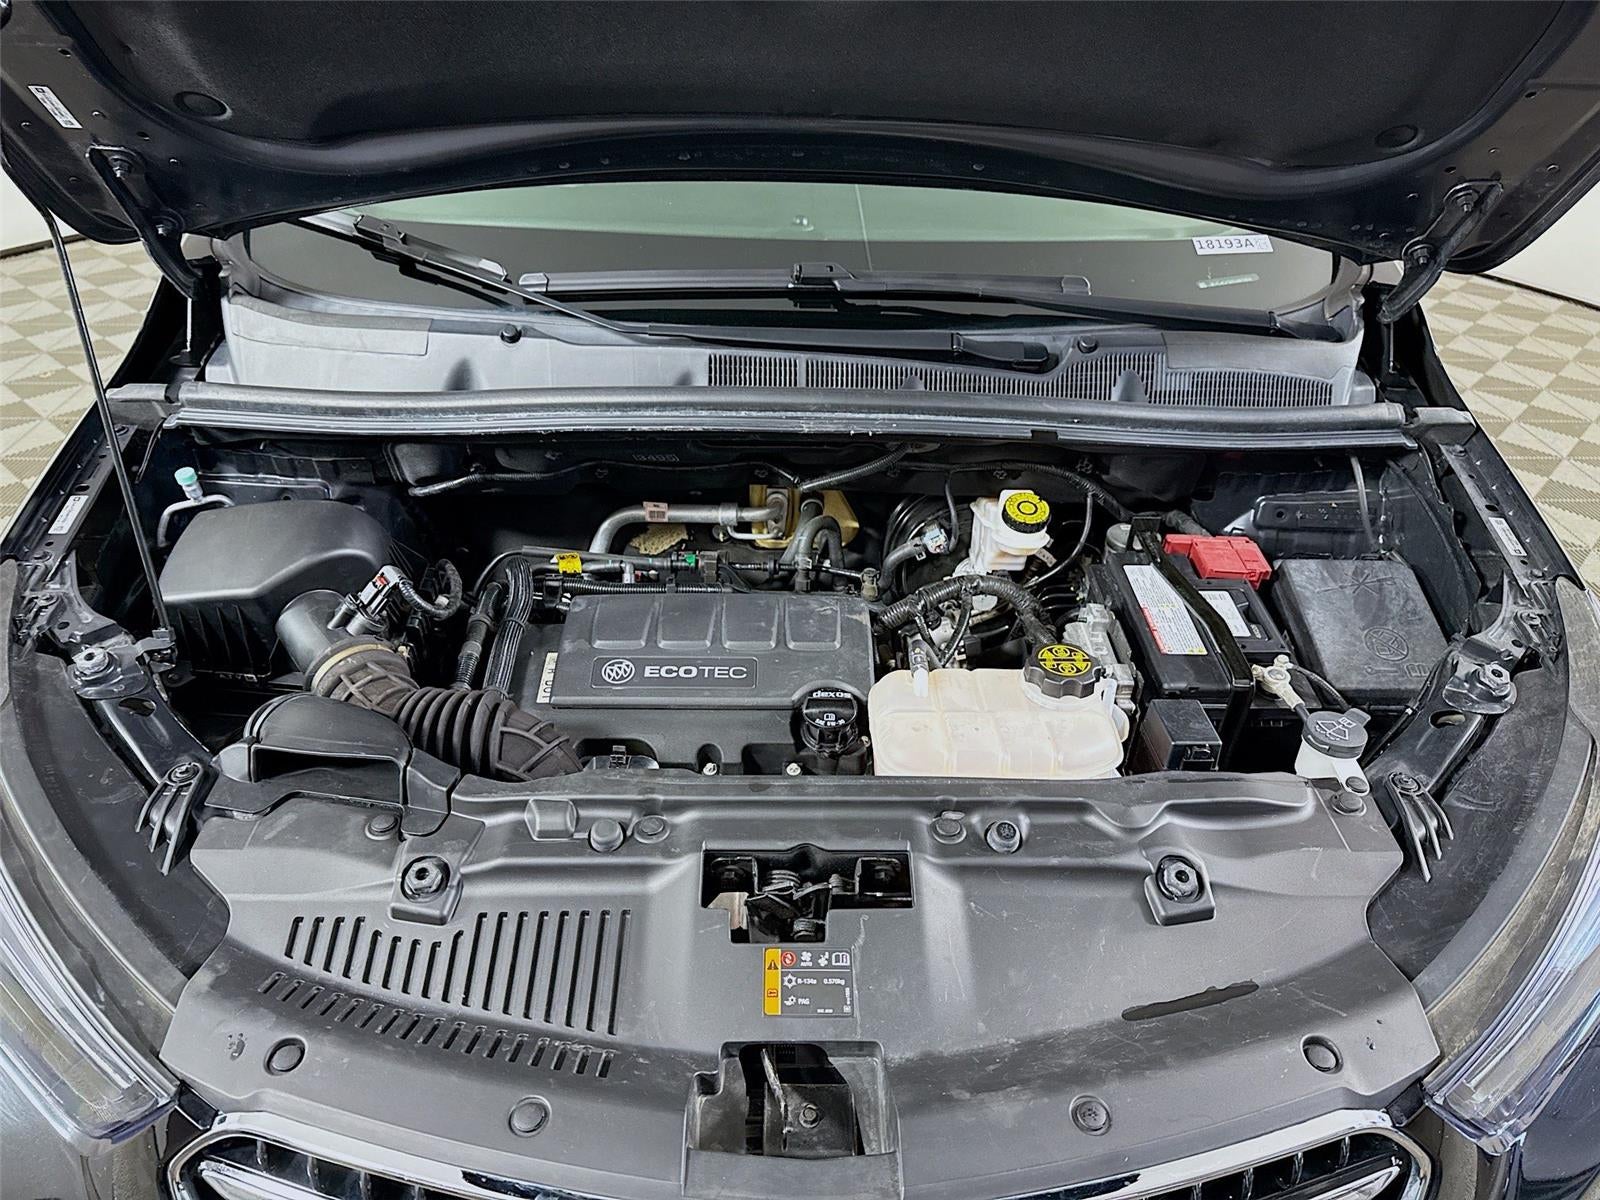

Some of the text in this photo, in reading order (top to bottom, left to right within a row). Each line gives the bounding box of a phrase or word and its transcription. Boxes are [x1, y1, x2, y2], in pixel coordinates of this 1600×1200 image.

[1195, 238, 1255, 250] 18193A
[643, 665, 748, 679] ECOTEC
[812, 690, 852, 699] dexos
